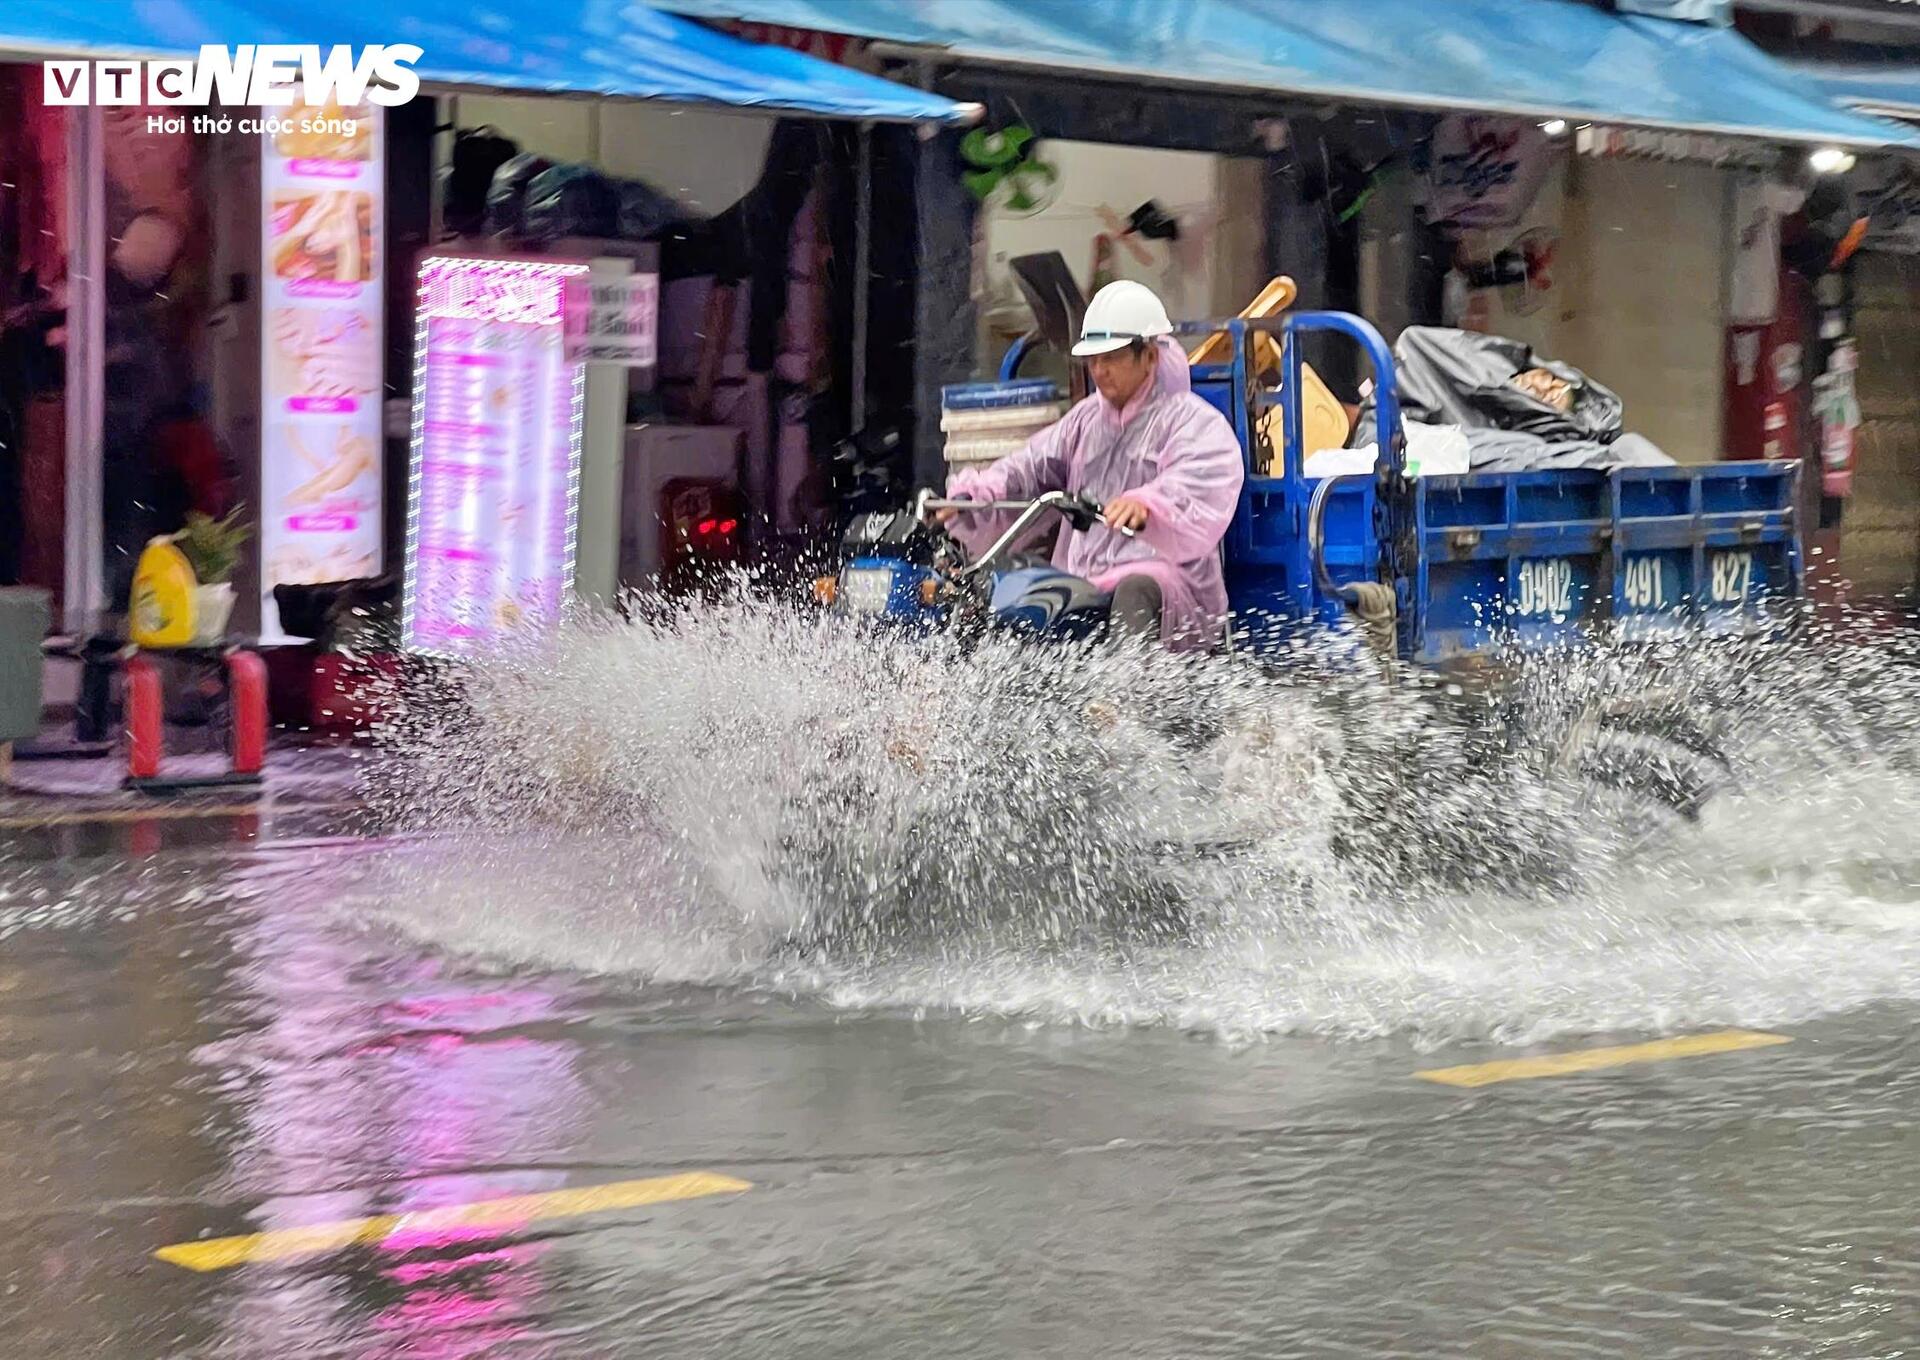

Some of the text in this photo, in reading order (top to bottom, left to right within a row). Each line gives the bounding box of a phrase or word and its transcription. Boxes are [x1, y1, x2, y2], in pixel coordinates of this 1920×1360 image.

[1520, 552, 1751, 616] 0902 491 827
